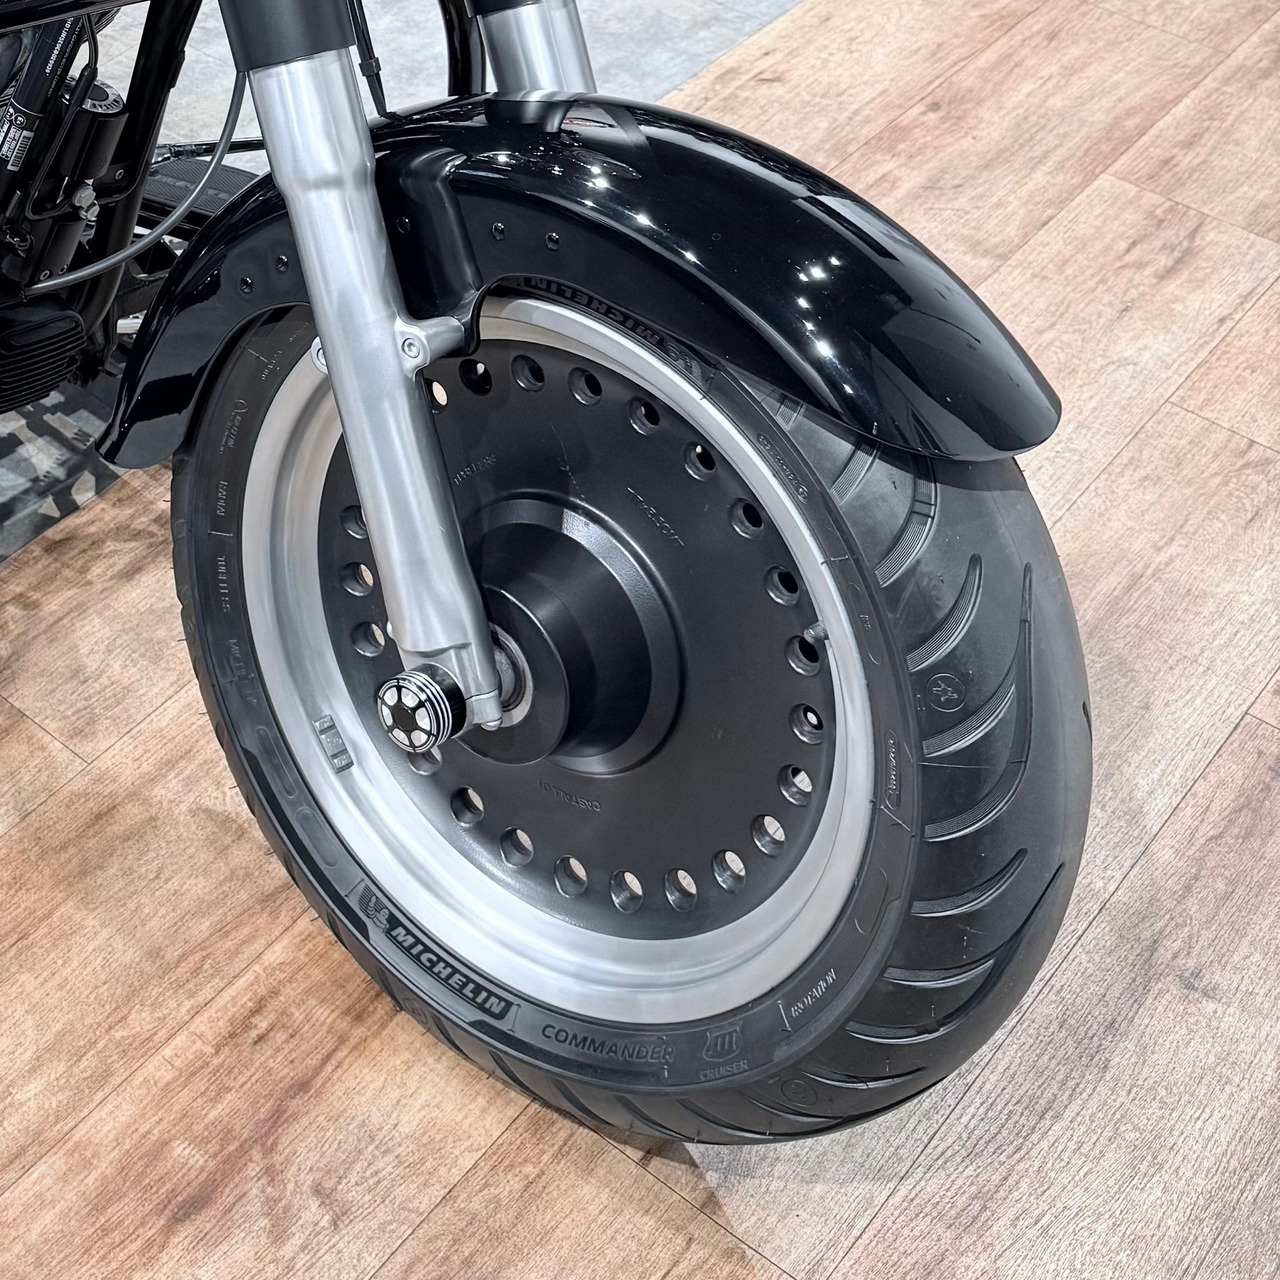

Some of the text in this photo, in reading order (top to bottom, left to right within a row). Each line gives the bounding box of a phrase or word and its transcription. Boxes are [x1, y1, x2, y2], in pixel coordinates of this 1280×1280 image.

[528, 275, 661, 345] MICHELIN
[391, 926, 507, 1014] MICHELIN
[541, 1023, 675, 1063] COMMANDER
[700, 1060, 748, 1081] CRUISER
